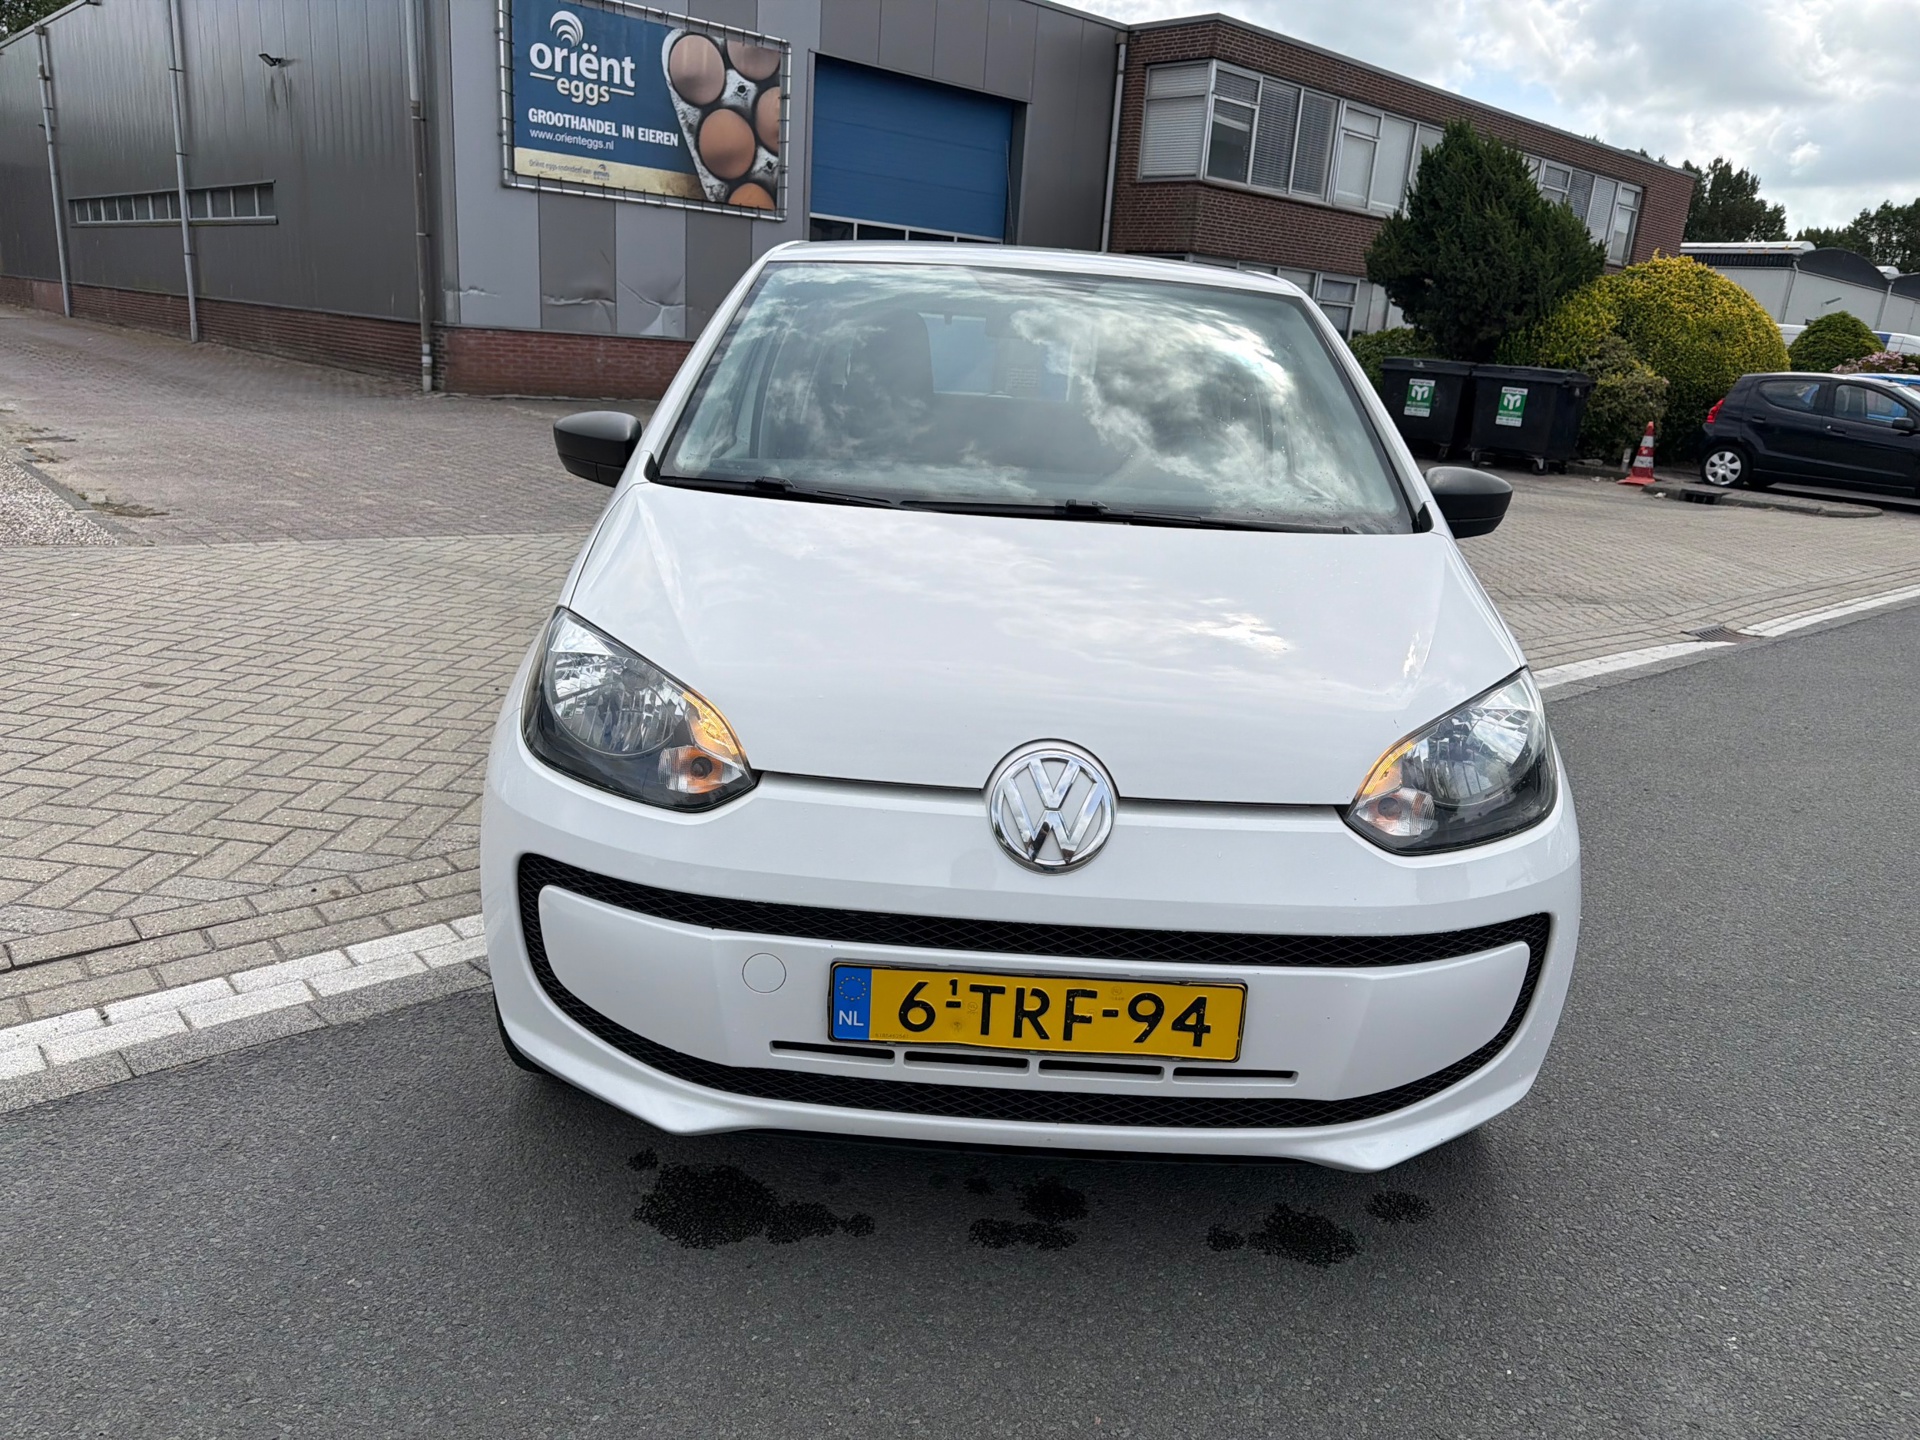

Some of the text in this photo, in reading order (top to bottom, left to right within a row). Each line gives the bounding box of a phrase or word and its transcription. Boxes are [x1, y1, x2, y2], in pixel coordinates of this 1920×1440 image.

[530, 42, 635, 87] oriënt
[557, 76, 610, 106] eggs
[528, 108, 678, 147] GROOTHANDEL IN EIEREN
[529, 129, 614, 150] www.orienteggs.nl
[993, 753, 1109, 869] VW
[838, 1010, 864, 1027] NL
